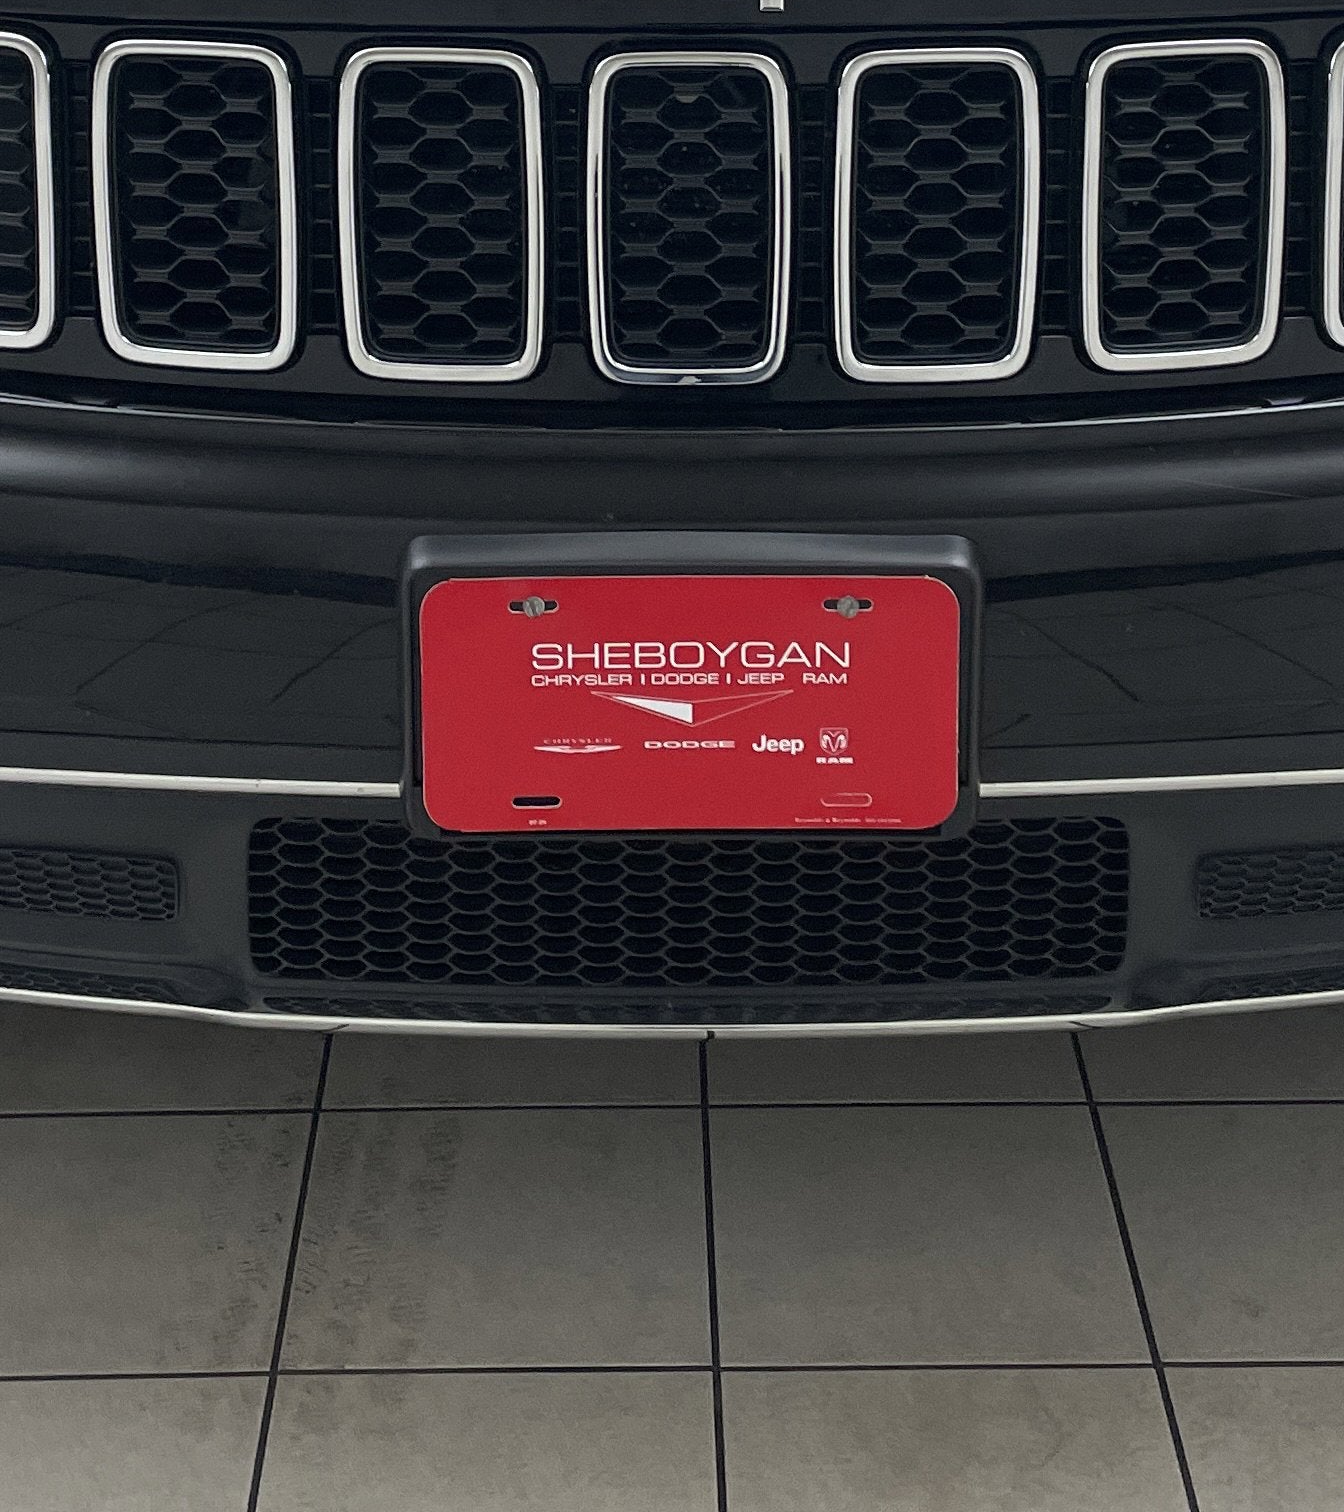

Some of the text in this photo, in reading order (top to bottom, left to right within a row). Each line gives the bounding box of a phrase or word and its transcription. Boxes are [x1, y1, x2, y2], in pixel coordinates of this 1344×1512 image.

[531, 641, 850, 670] SHEBOYGAN
[530, 673, 633, 687] CHRYSLER
[650, 673, 719, 686] DODGE
[736, 672, 785, 685] JEEP
[802, 672, 848, 685] RAM
[643, 740, 736, 749] DODGE
[751, 734, 805, 756] Jeep
[815, 756, 854, 764] RAM
